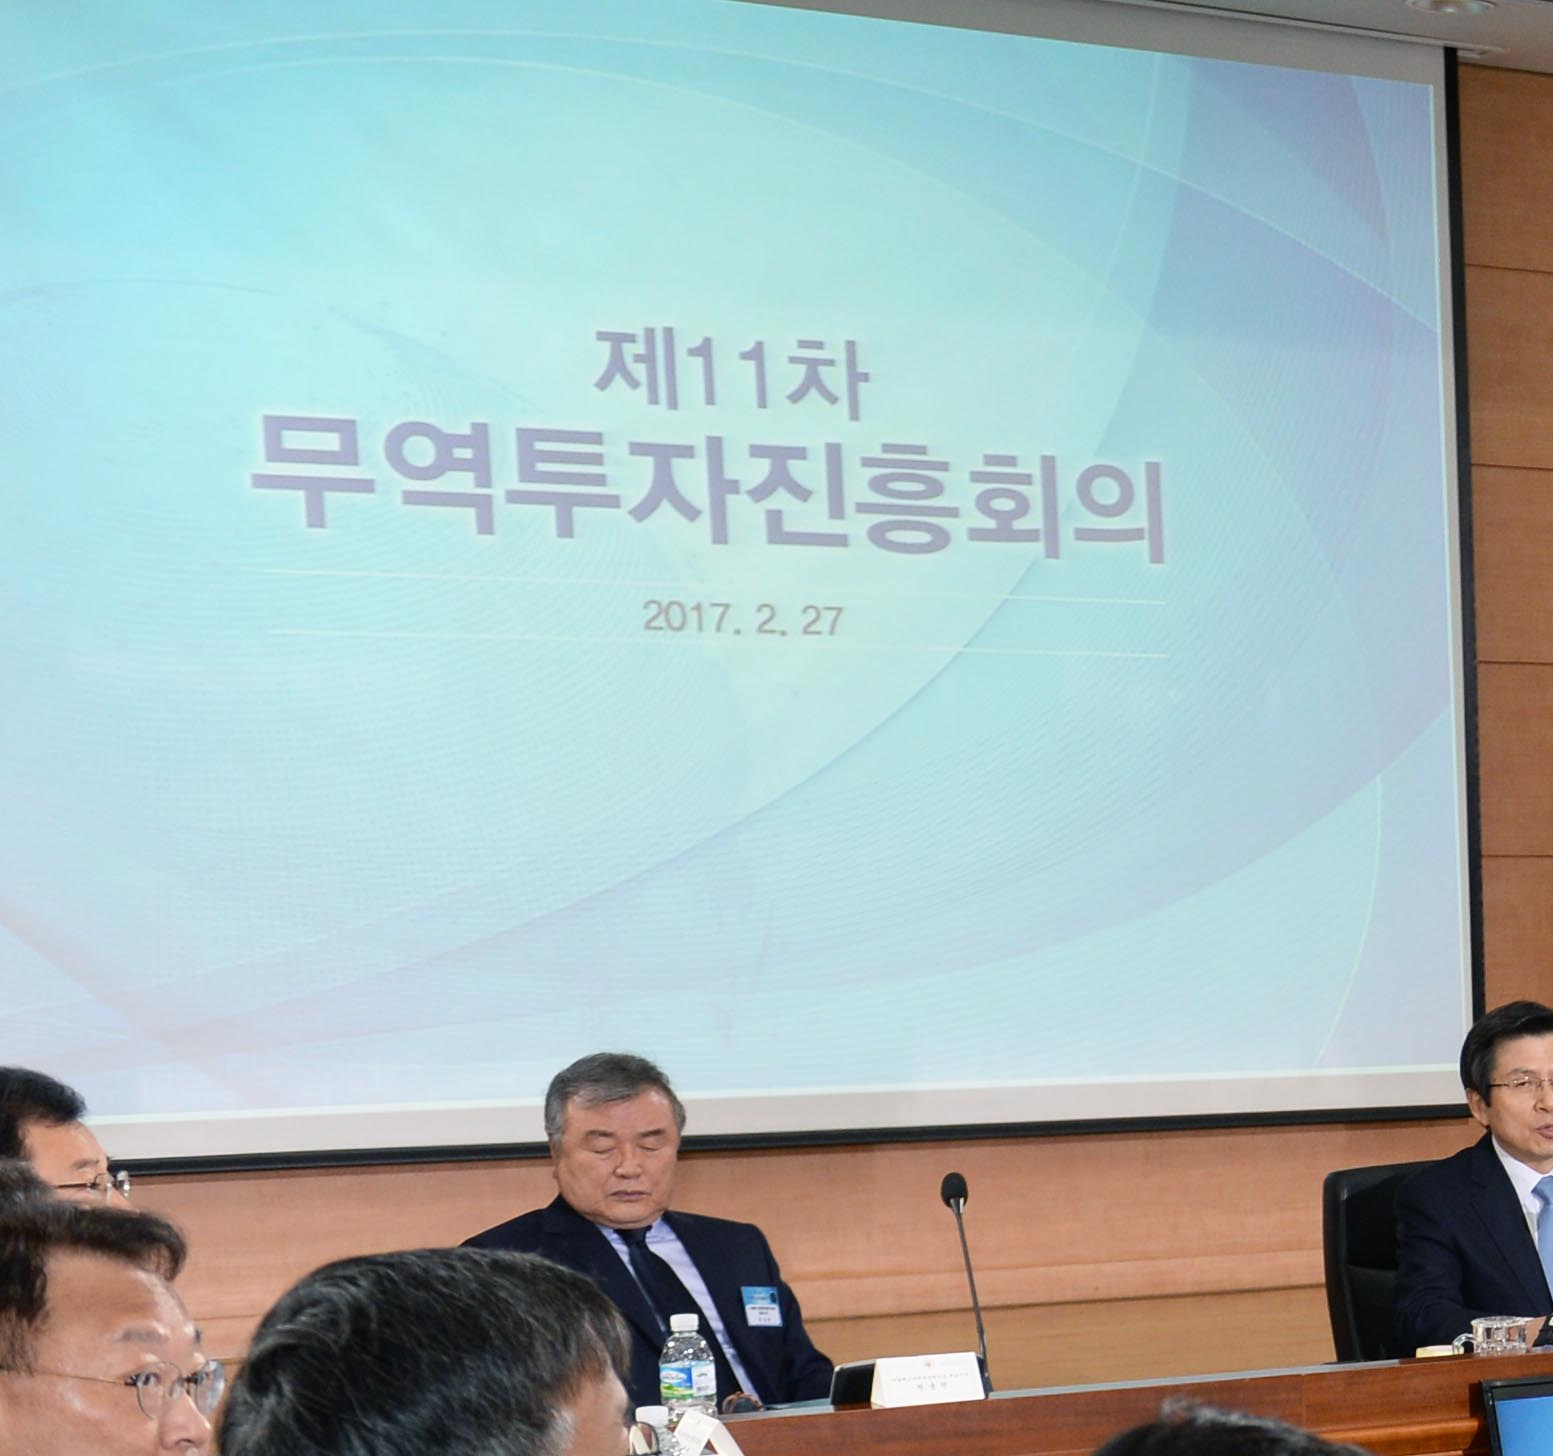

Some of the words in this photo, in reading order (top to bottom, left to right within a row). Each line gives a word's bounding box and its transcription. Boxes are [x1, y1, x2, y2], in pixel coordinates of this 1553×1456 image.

[594, 325, 871, 422] 제11차
[250, 412, 1168, 565] 무역투자진흥회의
[642, 598, 742, 637] 2017.
[756, 601, 788, 638] 2.
[803, 603, 845, 638] 27
